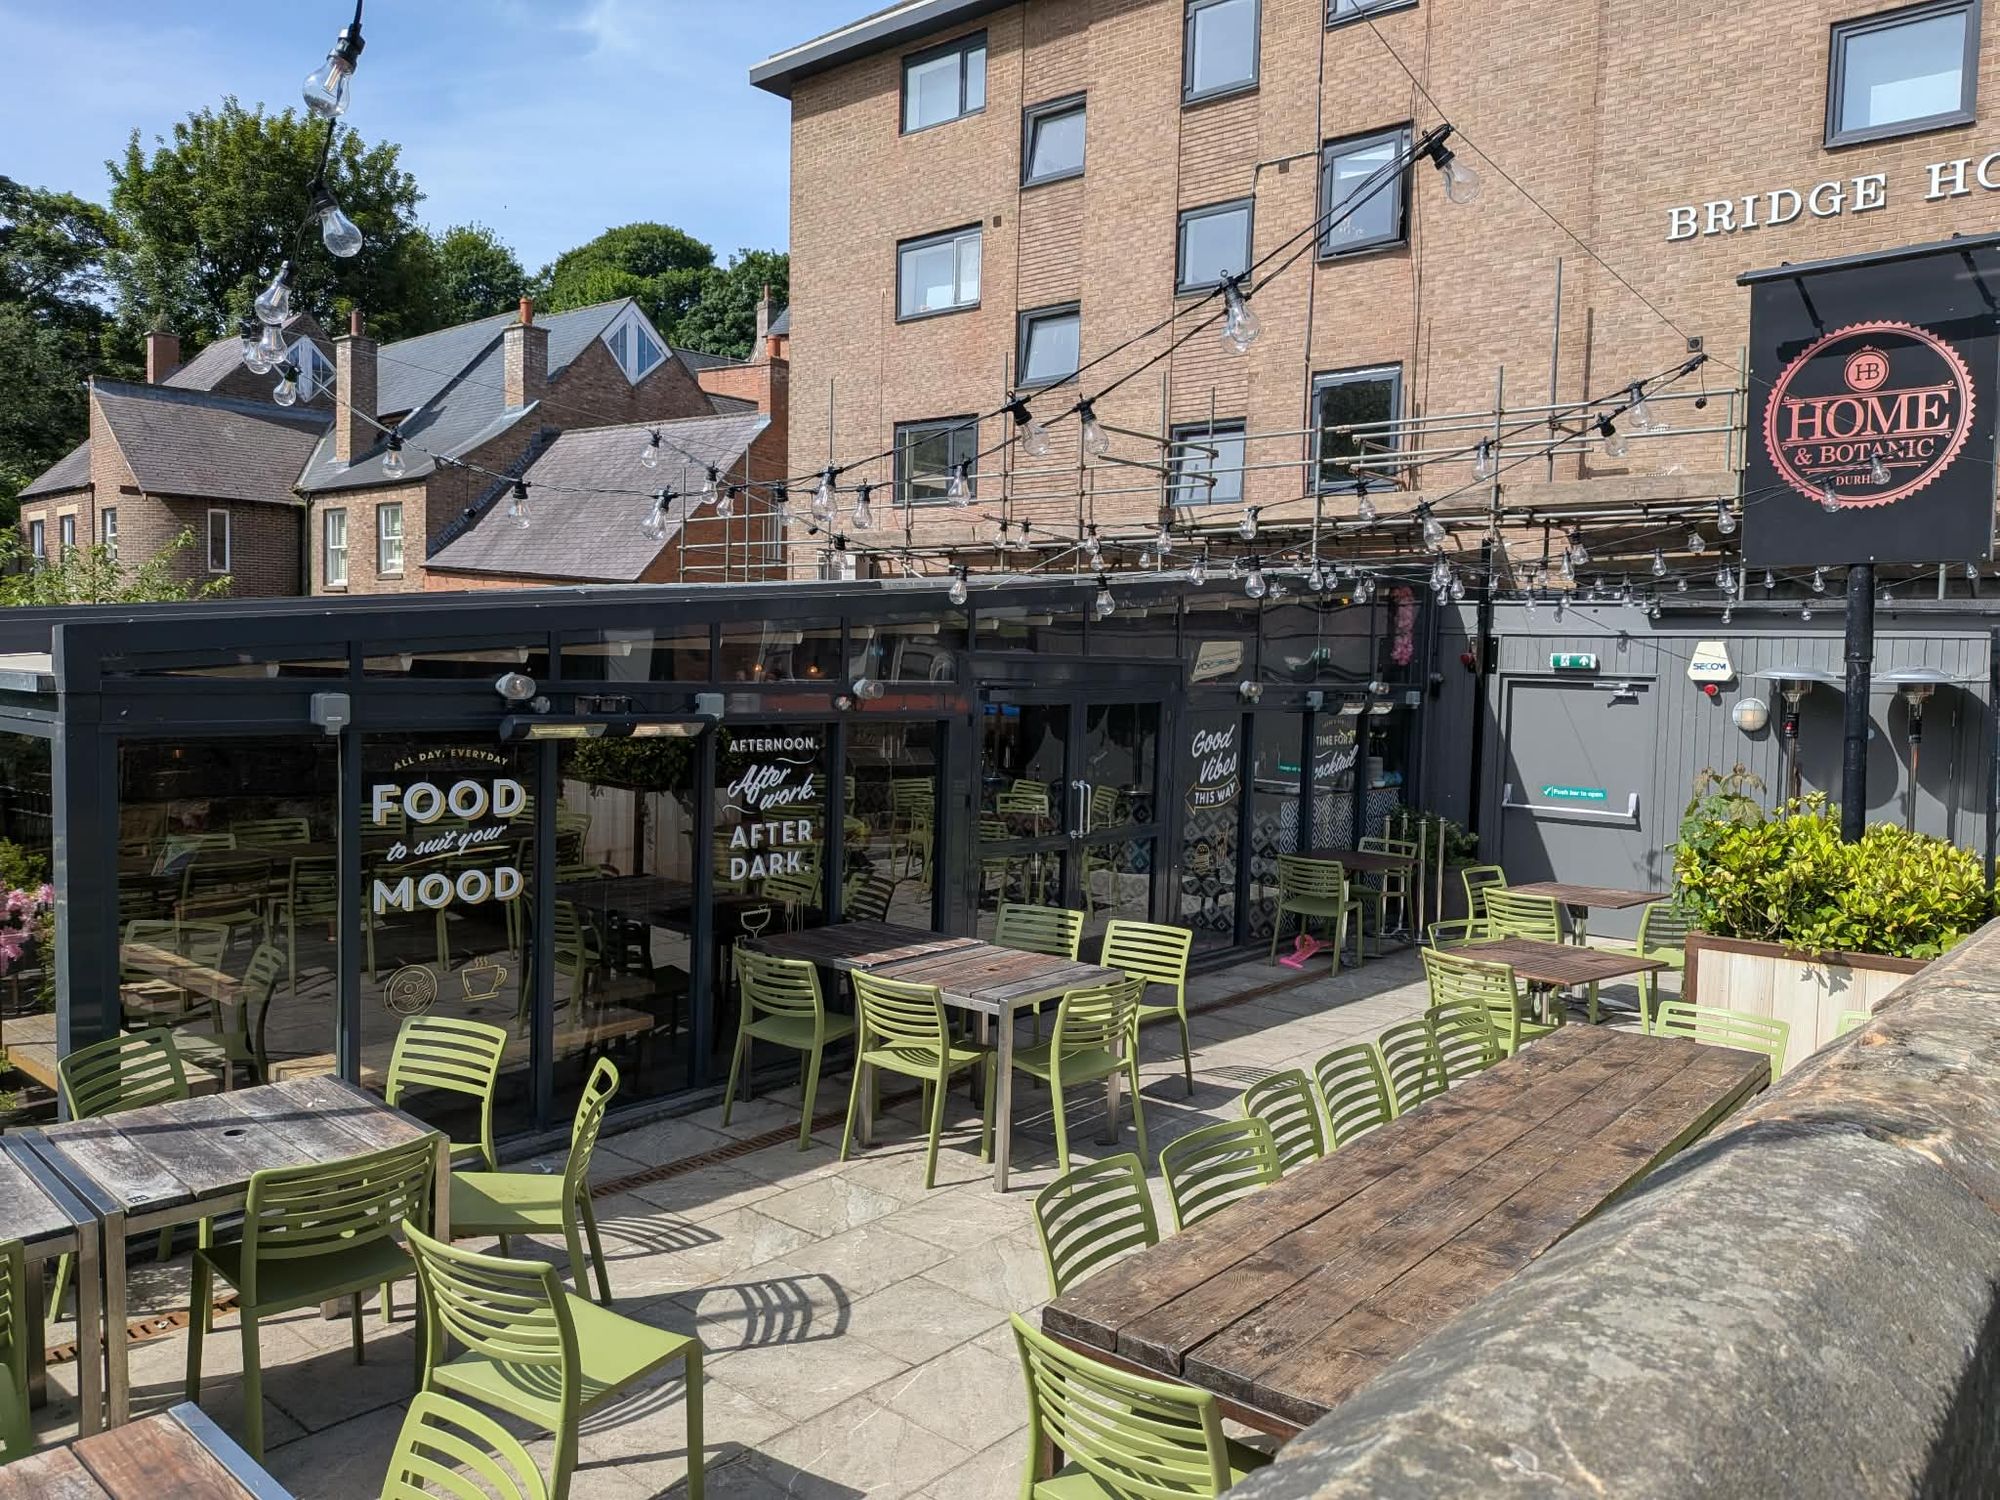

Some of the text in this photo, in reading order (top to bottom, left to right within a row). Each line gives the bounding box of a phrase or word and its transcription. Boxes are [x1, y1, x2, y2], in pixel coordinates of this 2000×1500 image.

[1666, 173, 1886, 241] BRIDGE
[1786, 390, 1949, 442] HOME
[1794, 438, 1934, 465] & BOTANIC
[1836, 473, 1890, 486] DURH
[1693, 662, 1727, 671] SECOM
[729, 737, 819, 752] AFTERNOON.
[1192, 723, 1236, 758] Good
[1315, 735, 1333, 747] TIME
[1334, 734, 1348, 746] FOR
[394, 748, 508, 771] ALL DAY, EVERYDAY
[1200, 752, 1237, 784] Vibes
[727, 764, 791, 804] After
[759, 773, 816, 811] work.
[1195, 782, 1236, 804] THIS WAY
[372, 778, 527, 826] FOOD
[386, 825, 507, 861] to suit your
[730, 820, 813, 849] AFTER
[730, 851, 811, 881] DARK.
[373, 867, 524, 915] MOOD
